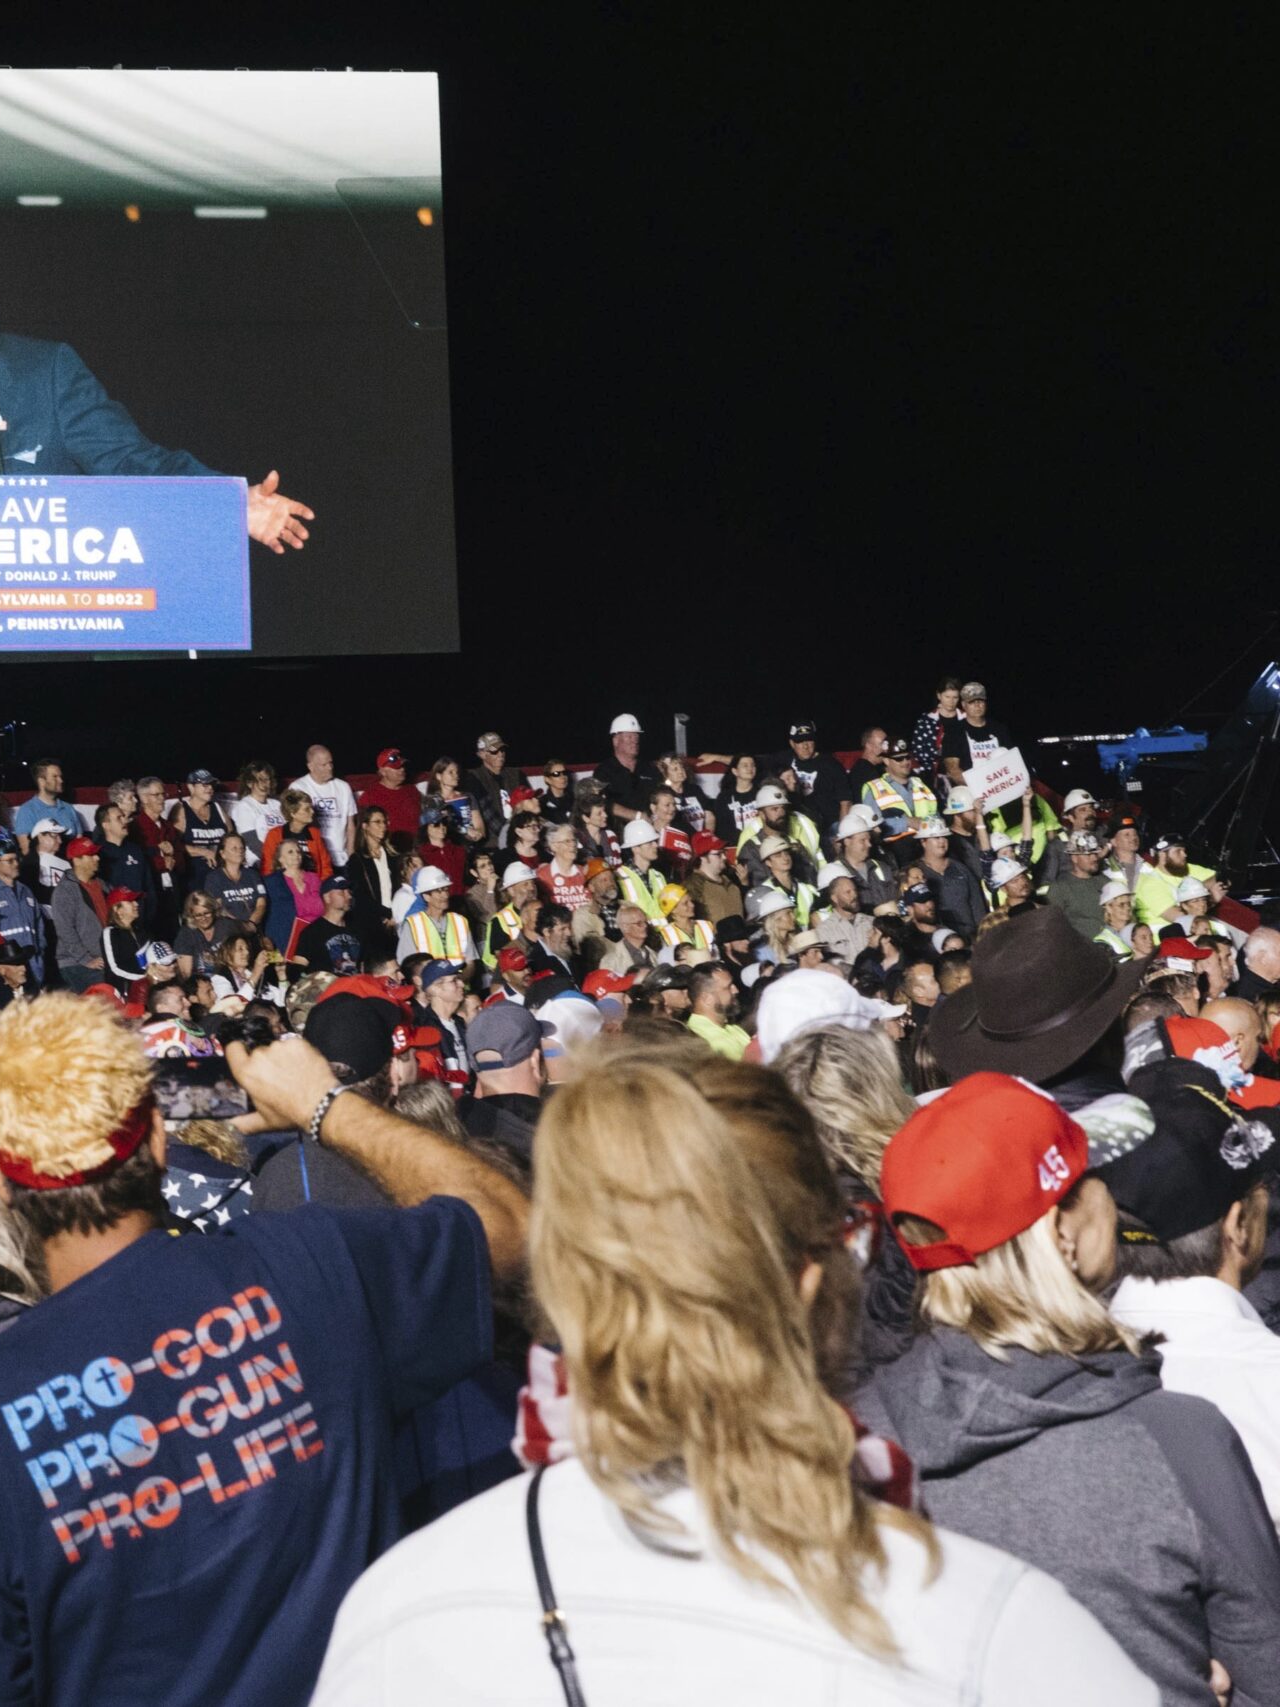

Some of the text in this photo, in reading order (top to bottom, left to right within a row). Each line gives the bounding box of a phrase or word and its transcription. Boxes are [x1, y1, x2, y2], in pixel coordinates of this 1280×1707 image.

[4, 570, 58, 582] DONALD
[61, 571, 71, 581] J.
[74, 570, 117, 581] TRUMP
[72, 593, 91, 606] TO
[96, 593, 143, 606] 88022
[7, 617, 125, 631] PENNSYLVANIA
[986, 766, 1010, 784] SAVE
[191, 828, 225, 839] TRUMP
[223, 887, 254, 898] TRUMP
[1037, 1144, 1070, 1192] 45
[0, 1285, 282, 1451] PRO-GOD
[25, 1342, 305, 1510] PRO-GUN
[50, 1401, 326, 1564] PRO-LIFE
